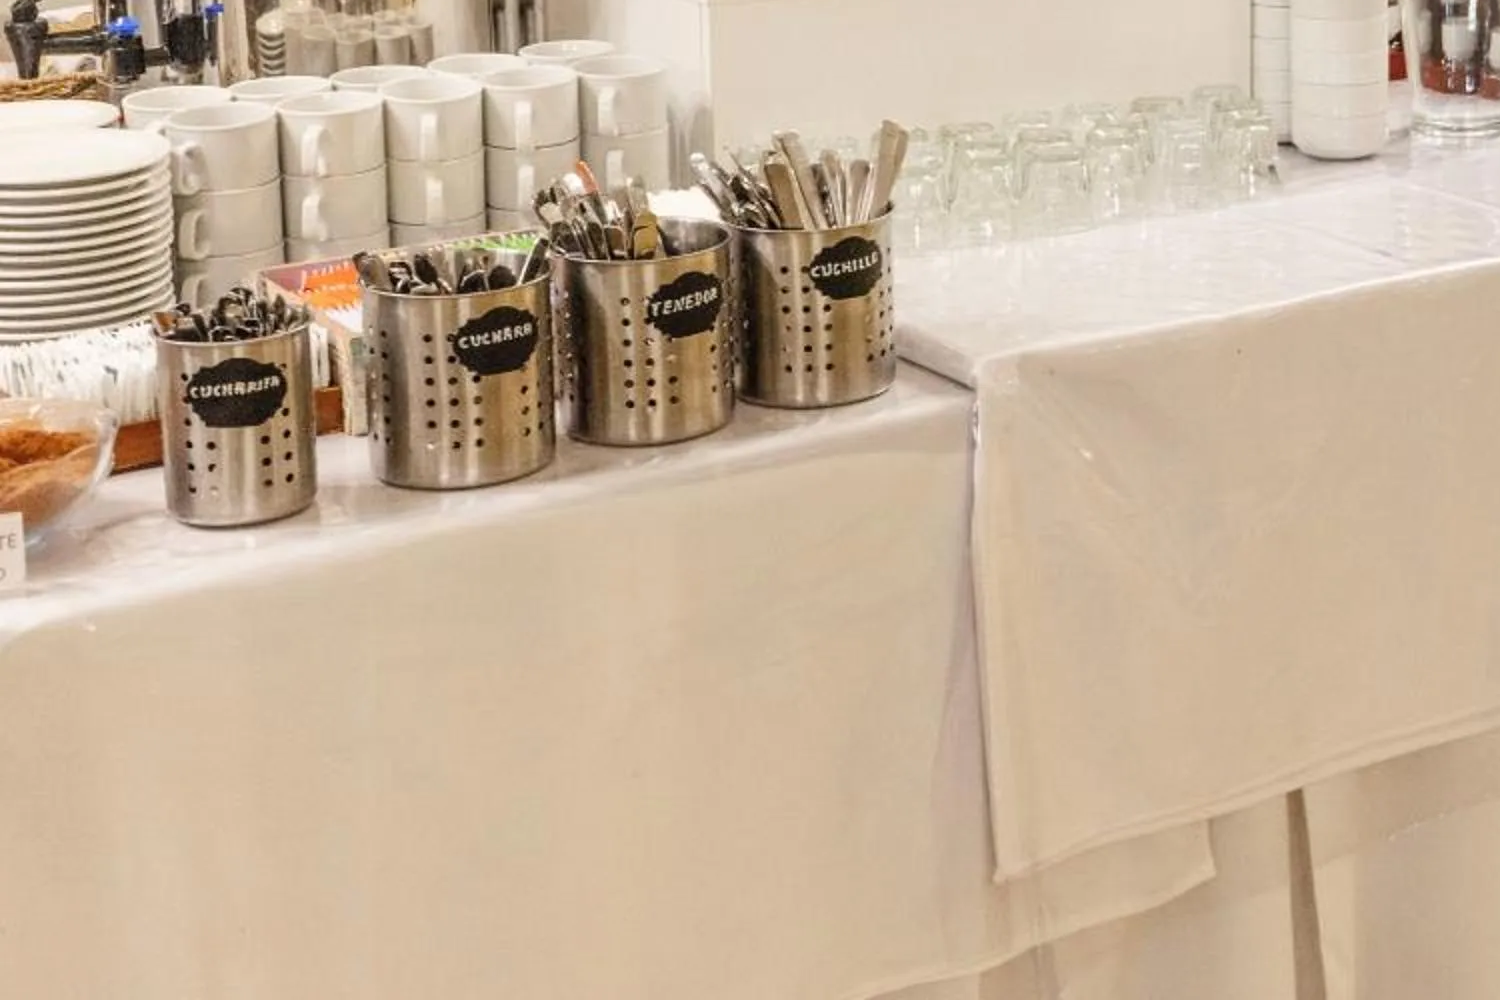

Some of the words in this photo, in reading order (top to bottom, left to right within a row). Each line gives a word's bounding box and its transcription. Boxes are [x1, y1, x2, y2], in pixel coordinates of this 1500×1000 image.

[809, 250, 880, 278] CUCHILLO
[650, 286, 719, 318] TENEDOR
[457, 321, 534, 350] CUCHARA
